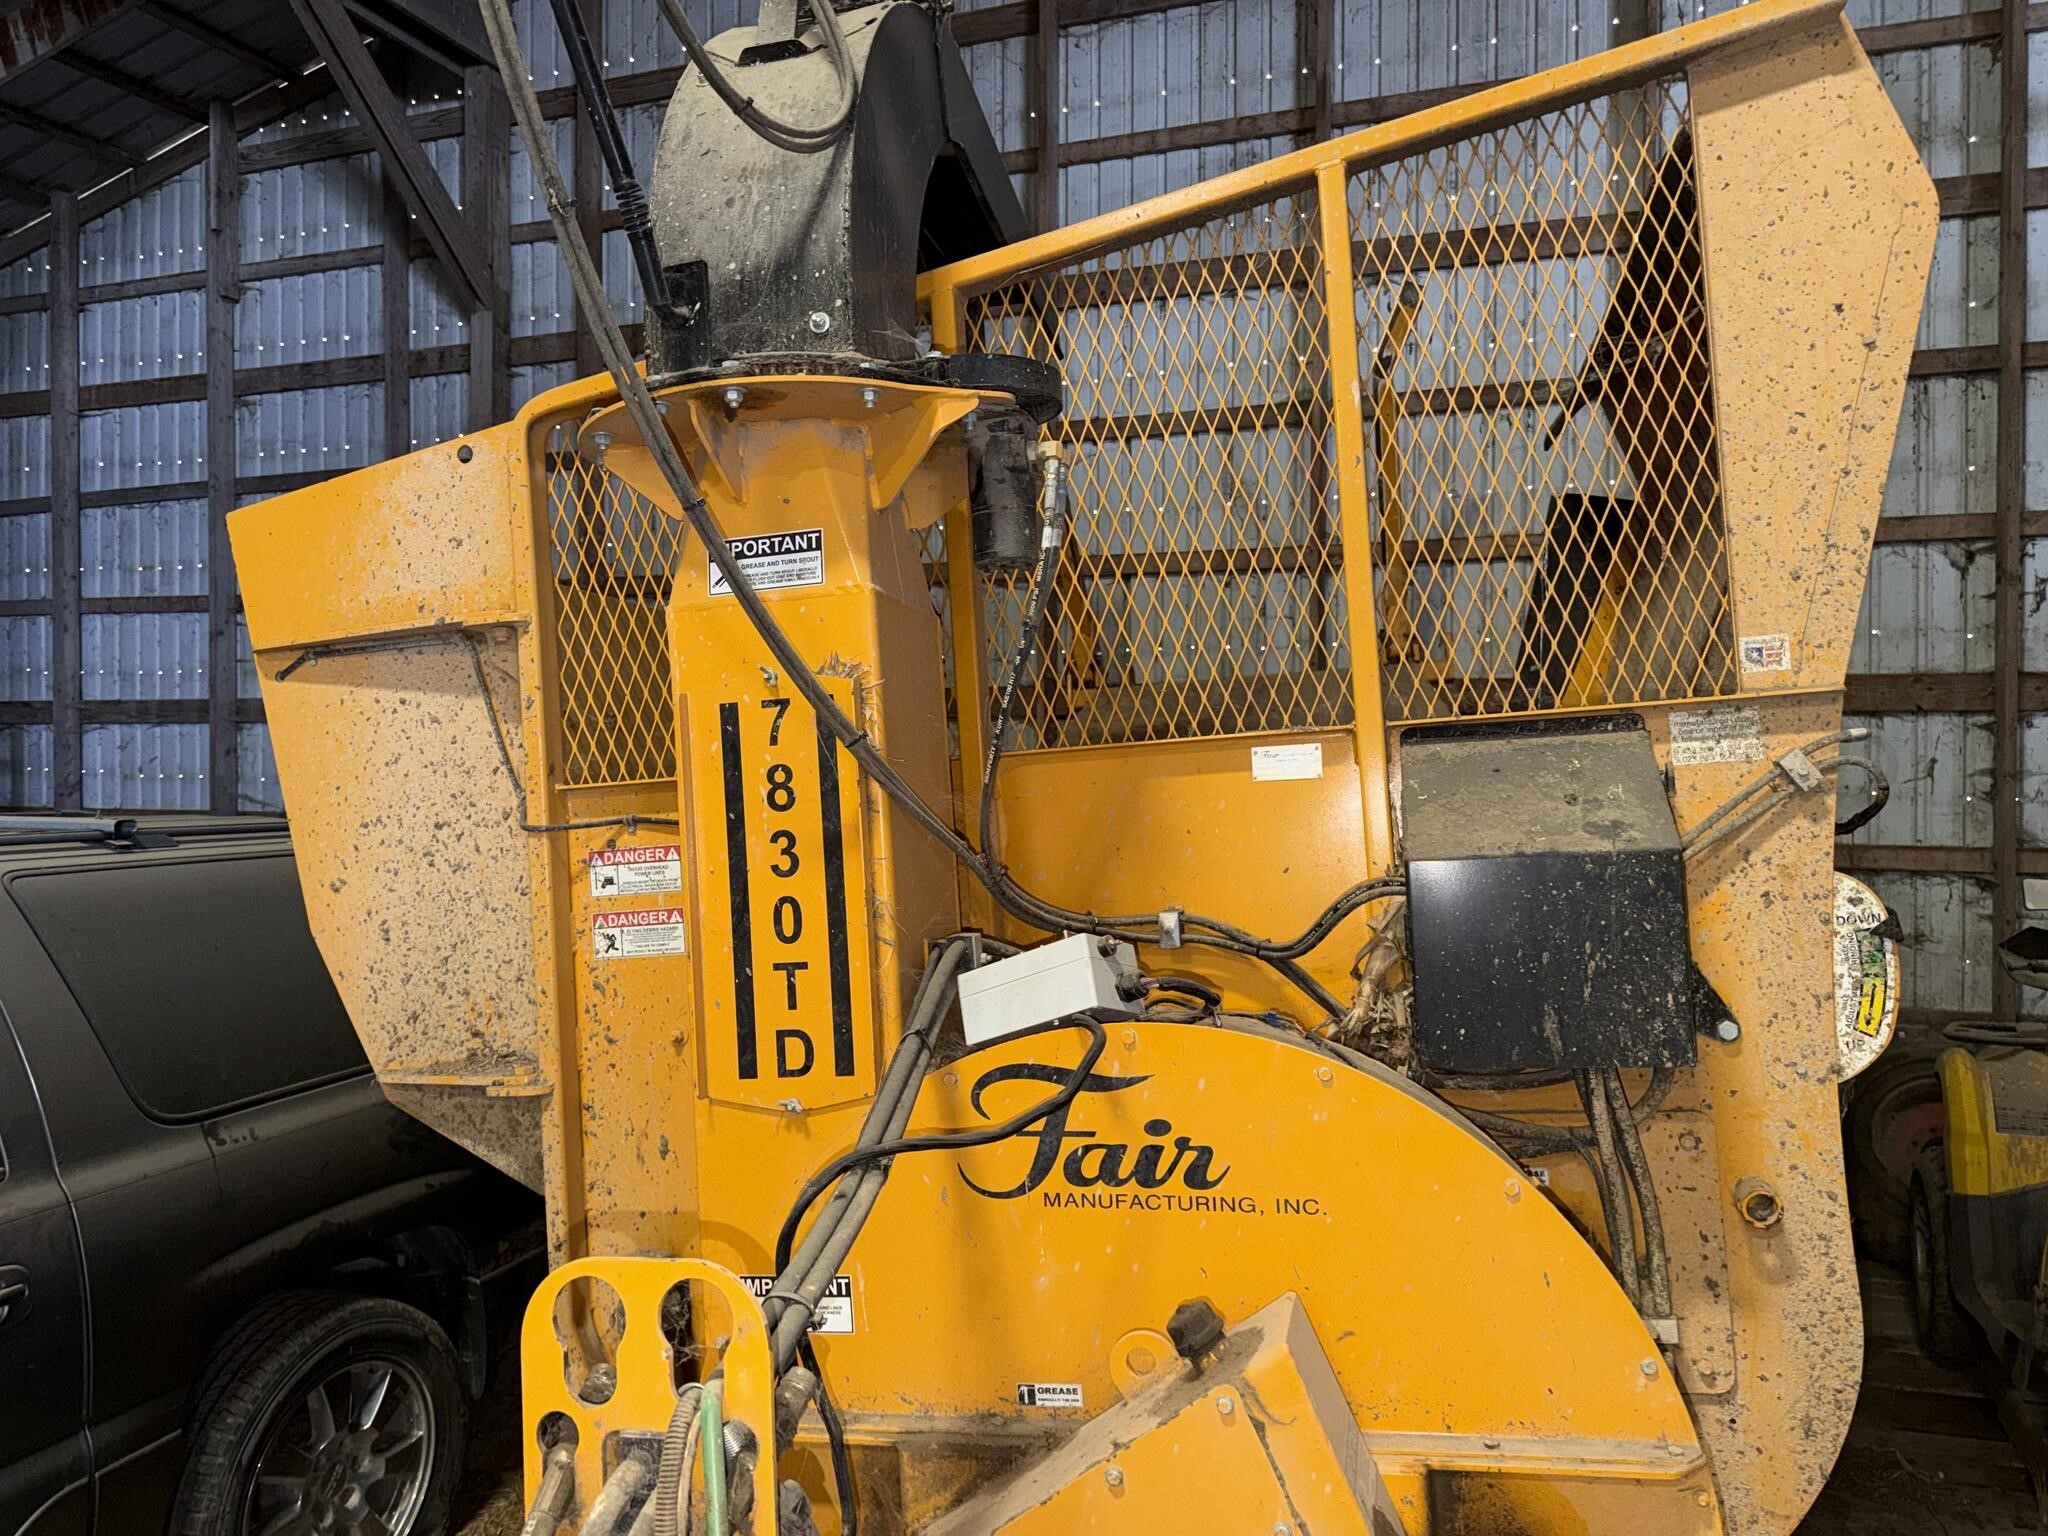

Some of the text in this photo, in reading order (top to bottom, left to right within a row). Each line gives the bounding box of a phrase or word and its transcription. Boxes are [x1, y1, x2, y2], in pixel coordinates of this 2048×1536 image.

[725, 532, 820, 557] PORTANT
[741, 555, 819, 570] GREASE AND TURN SPOUT
[1036, 560, 1045, 582] MSHA
[603, 848, 666, 866] DANGER
[607, 911, 670, 928] DANGER
[1836, 911, 1882, 927] DOWN
[957, 1062, 1231, 1200] Fair
[1043, 1191, 1329, 1217] MANUFACTURING, INC.
[1037, 1386, 1079, 1396] GREASE
